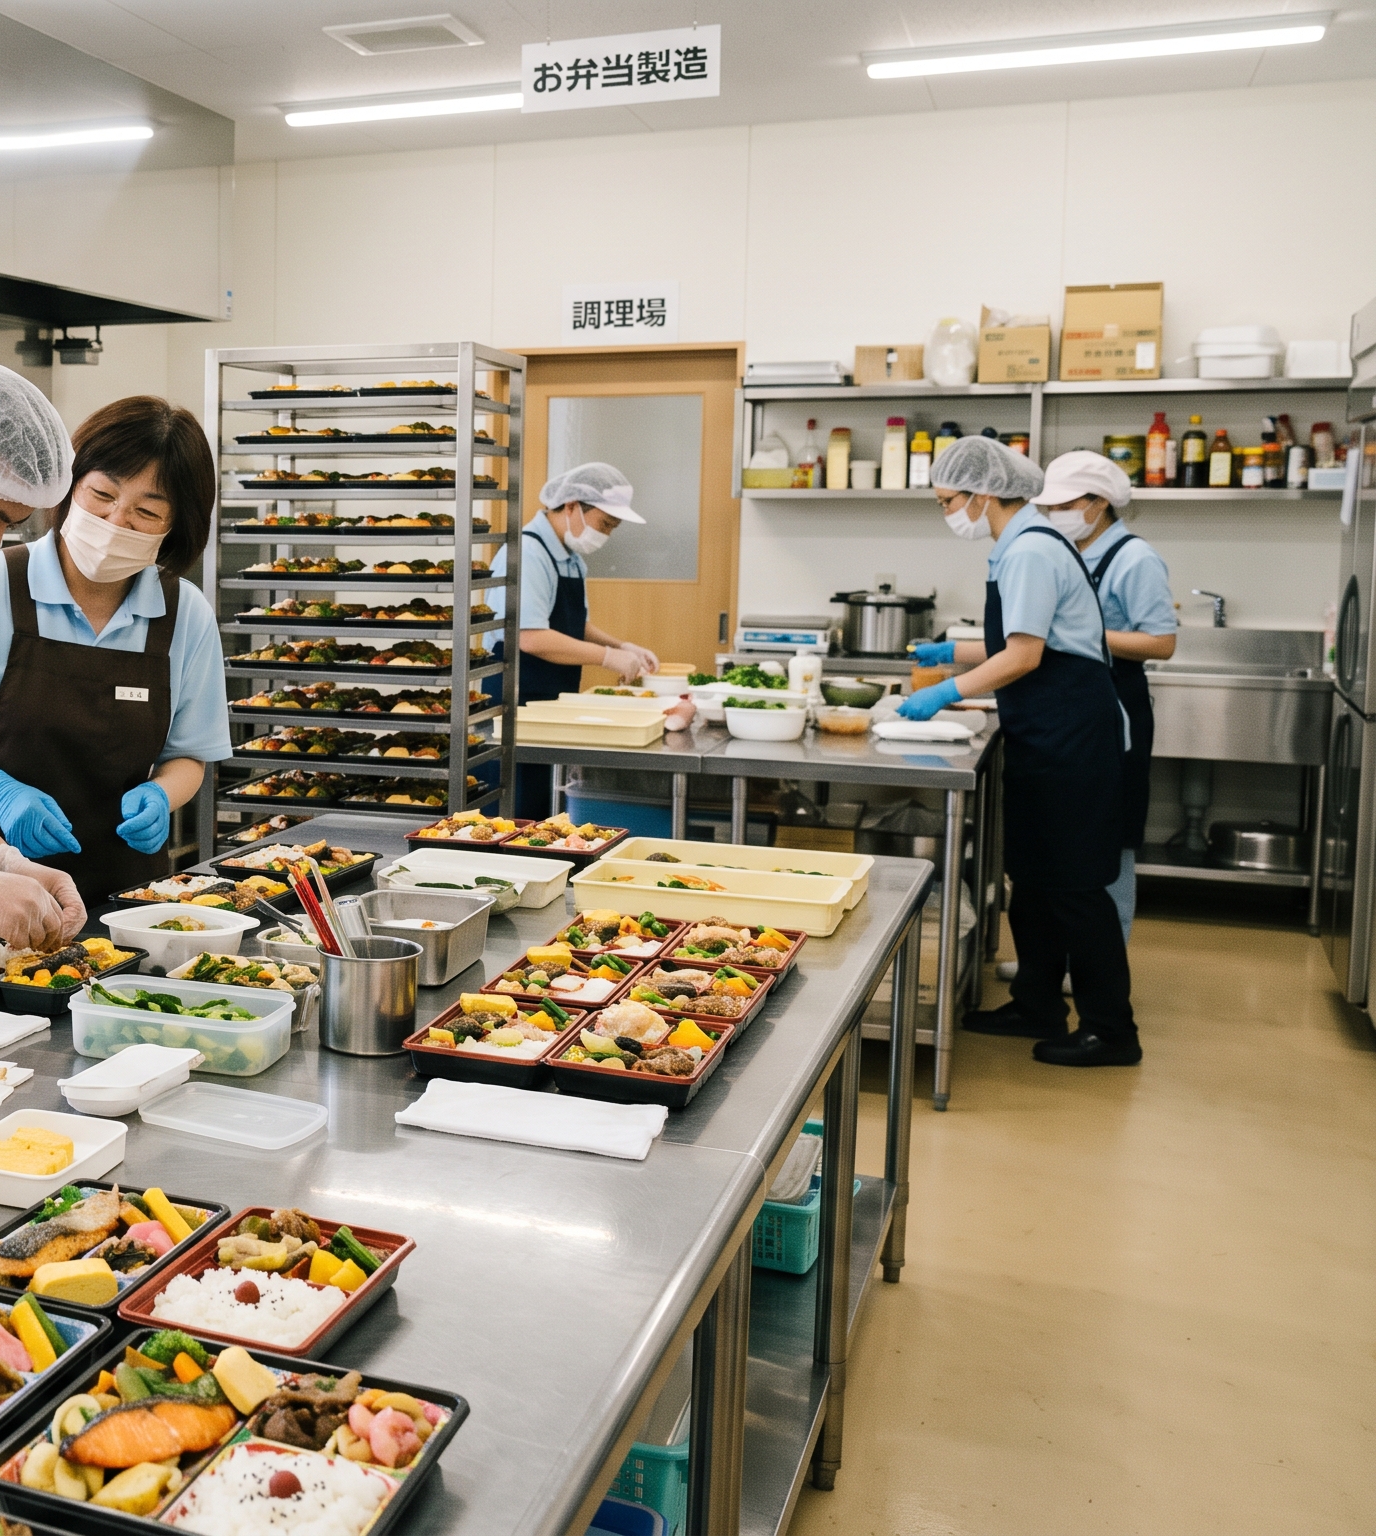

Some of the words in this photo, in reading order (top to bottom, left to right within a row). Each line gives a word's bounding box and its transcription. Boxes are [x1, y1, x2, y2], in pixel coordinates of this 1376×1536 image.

[533, 46, 708, 93] お弁当製造
[572, 298, 667, 330] 調理場
